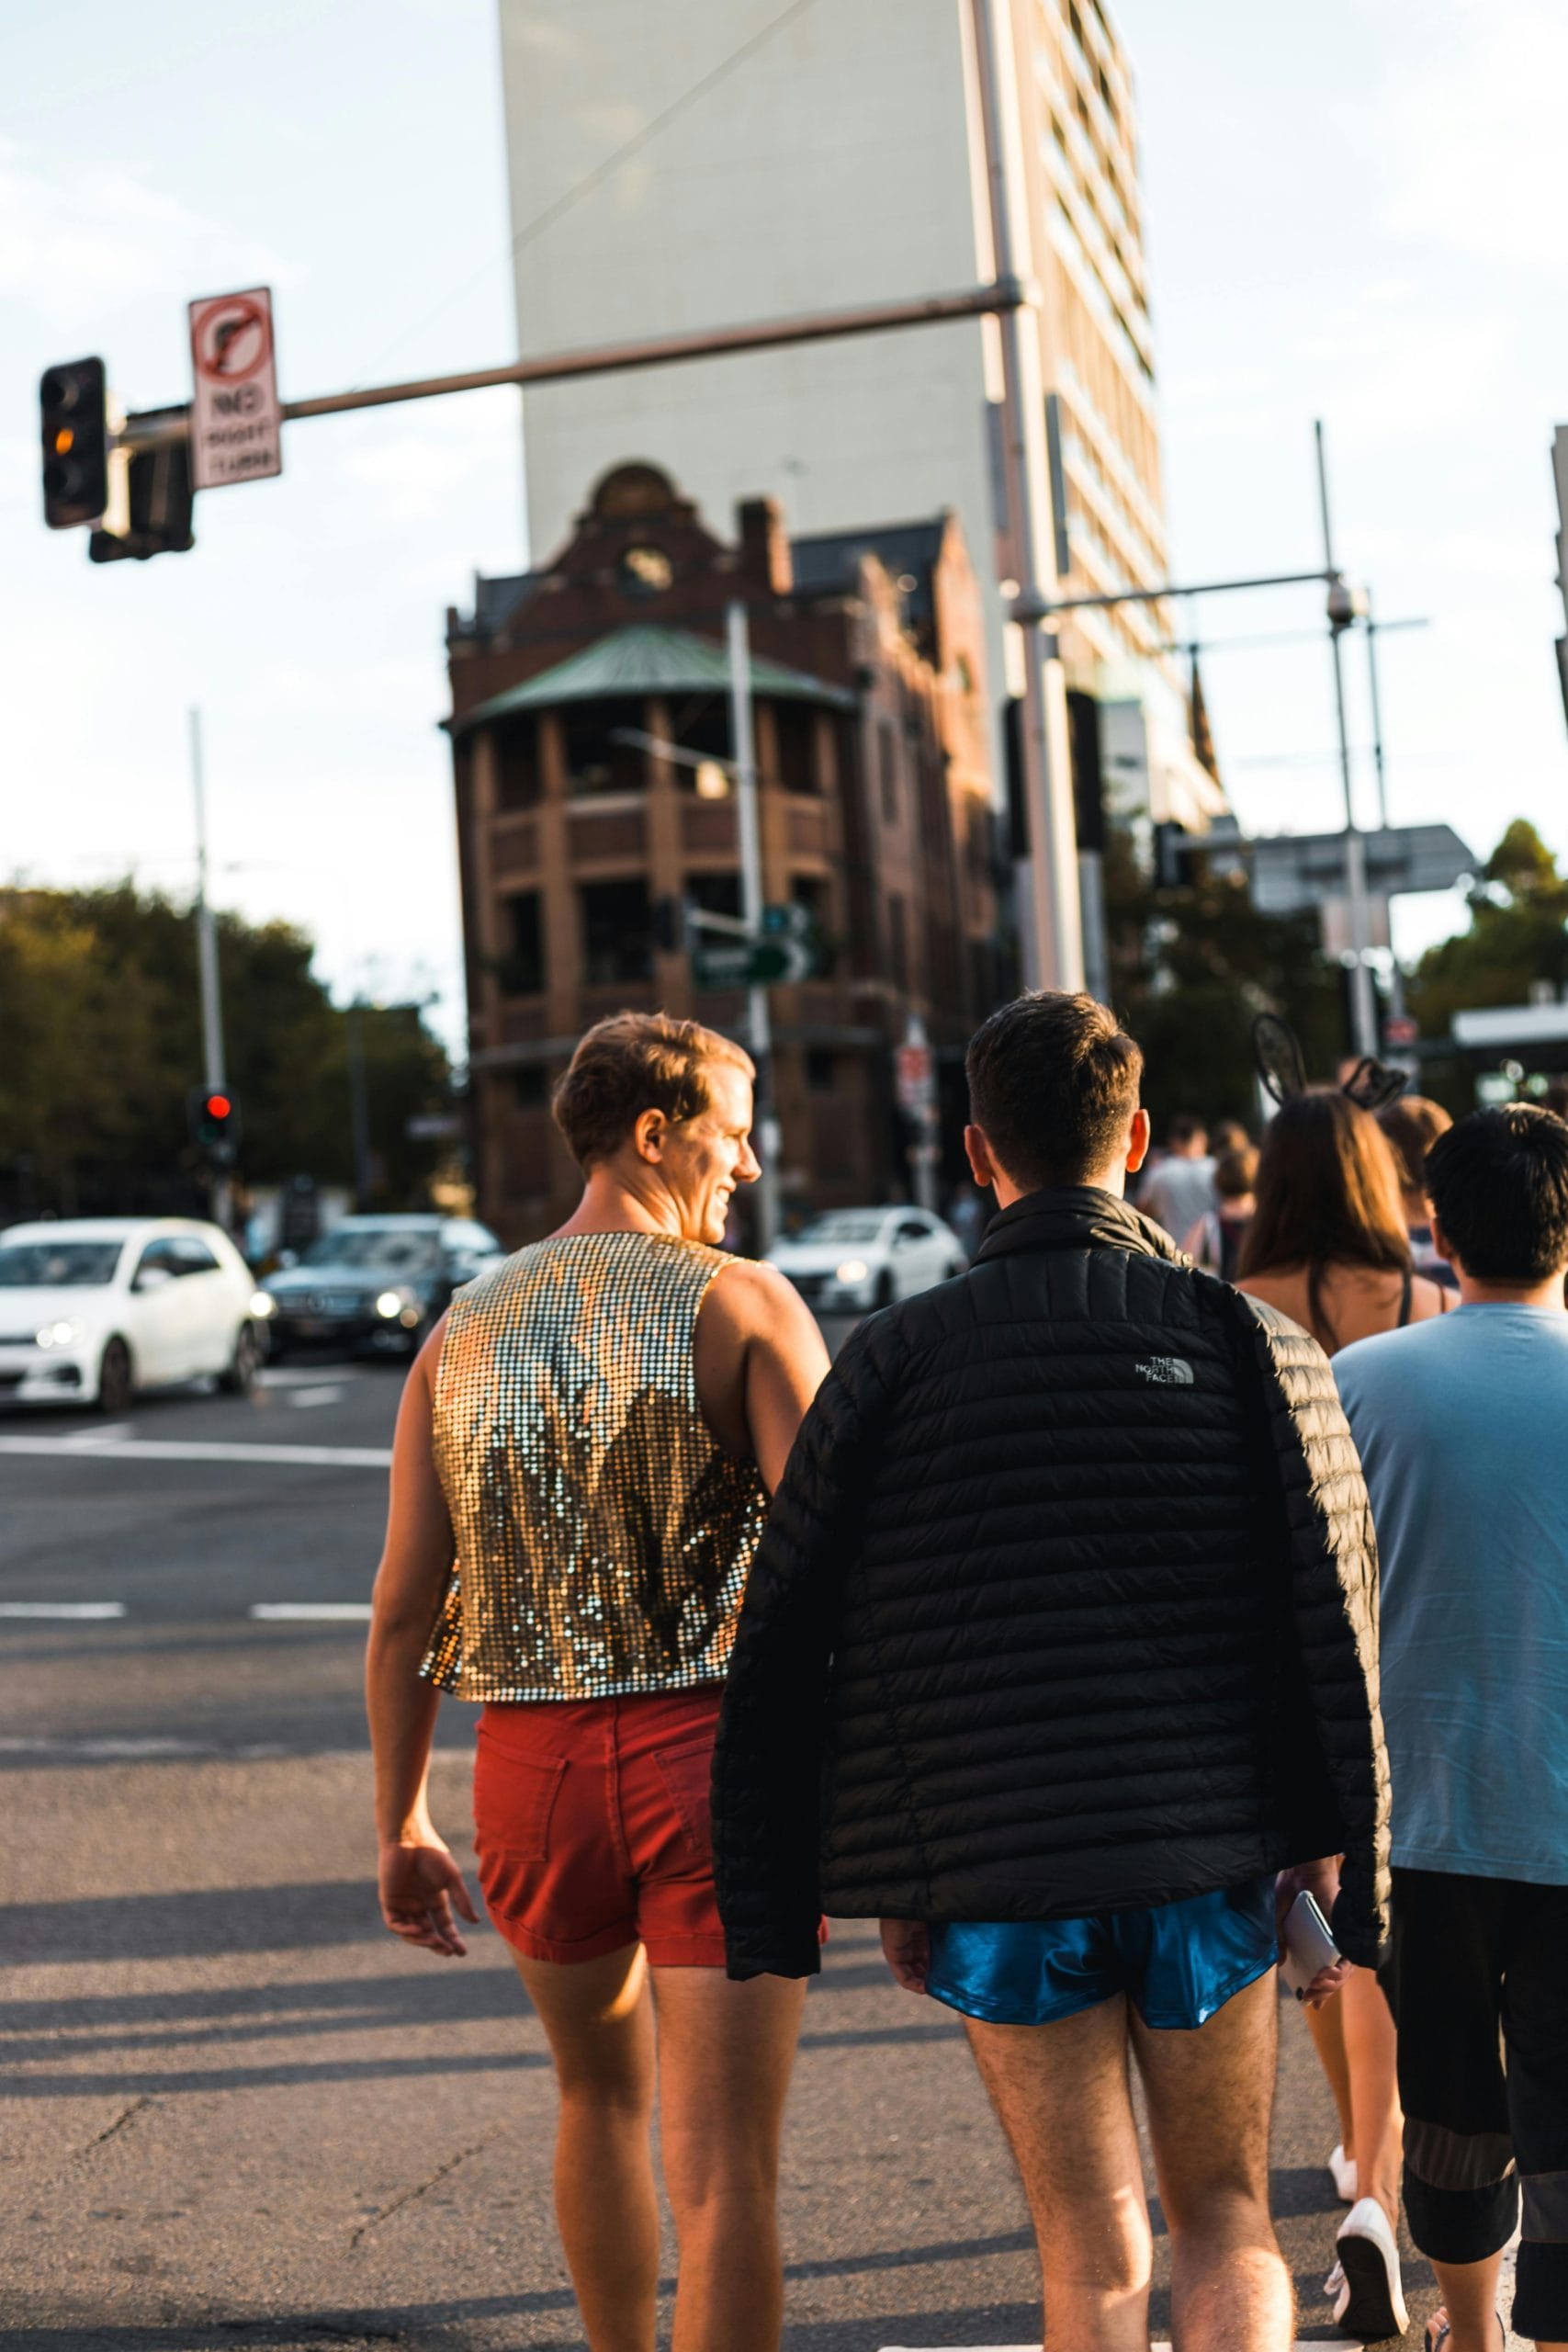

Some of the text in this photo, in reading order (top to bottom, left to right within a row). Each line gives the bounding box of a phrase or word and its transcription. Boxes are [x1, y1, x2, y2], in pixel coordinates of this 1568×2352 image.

[1150, 1356, 1173, 1366] THE
[1134, 1363, 1174, 1374] NORTH
[1145, 1373, 1175, 1384] FACE
